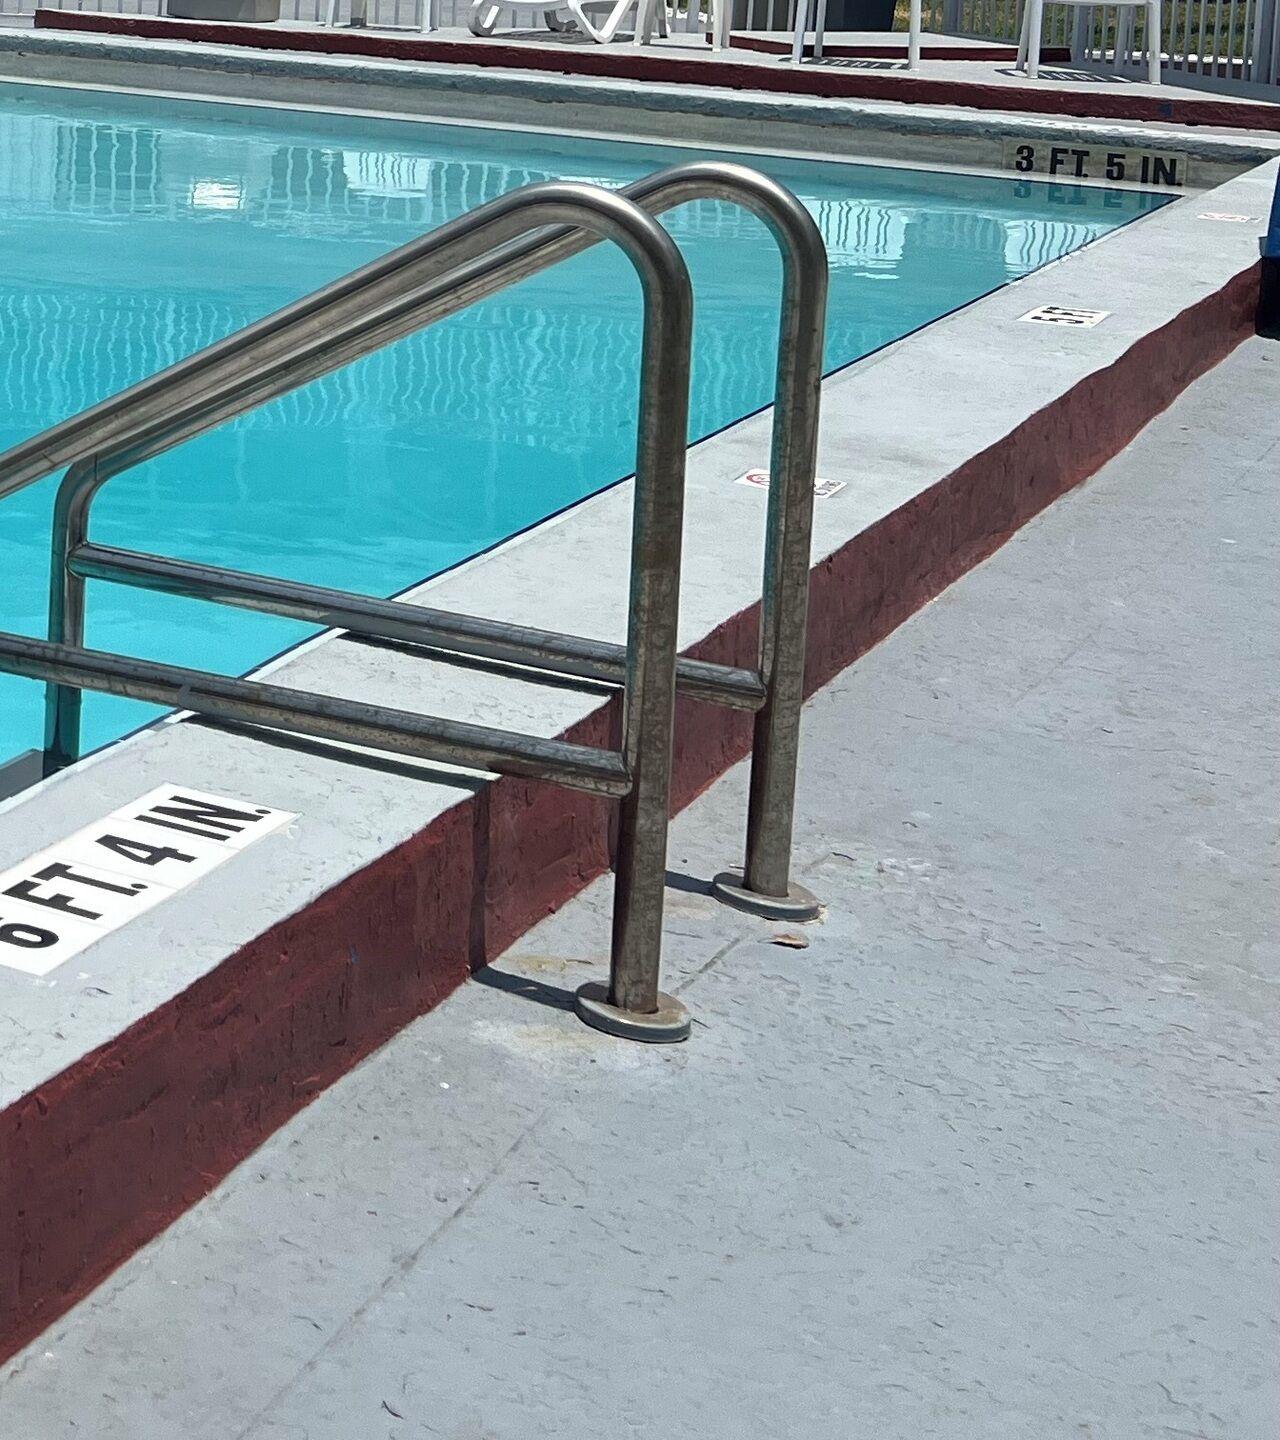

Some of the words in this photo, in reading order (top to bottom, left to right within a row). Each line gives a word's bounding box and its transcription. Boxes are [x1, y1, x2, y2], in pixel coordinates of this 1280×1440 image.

[1015, 145, 1035, 172] 3
[1049, 147, 1090, 178] FT.
[1106, 153, 1126, 181] 5
[1140, 156, 1183, 186] IN.
[133, 795, 272, 842] IN.
[94, 833, 199, 866] 4
[0, 862, 149, 921] FT.
